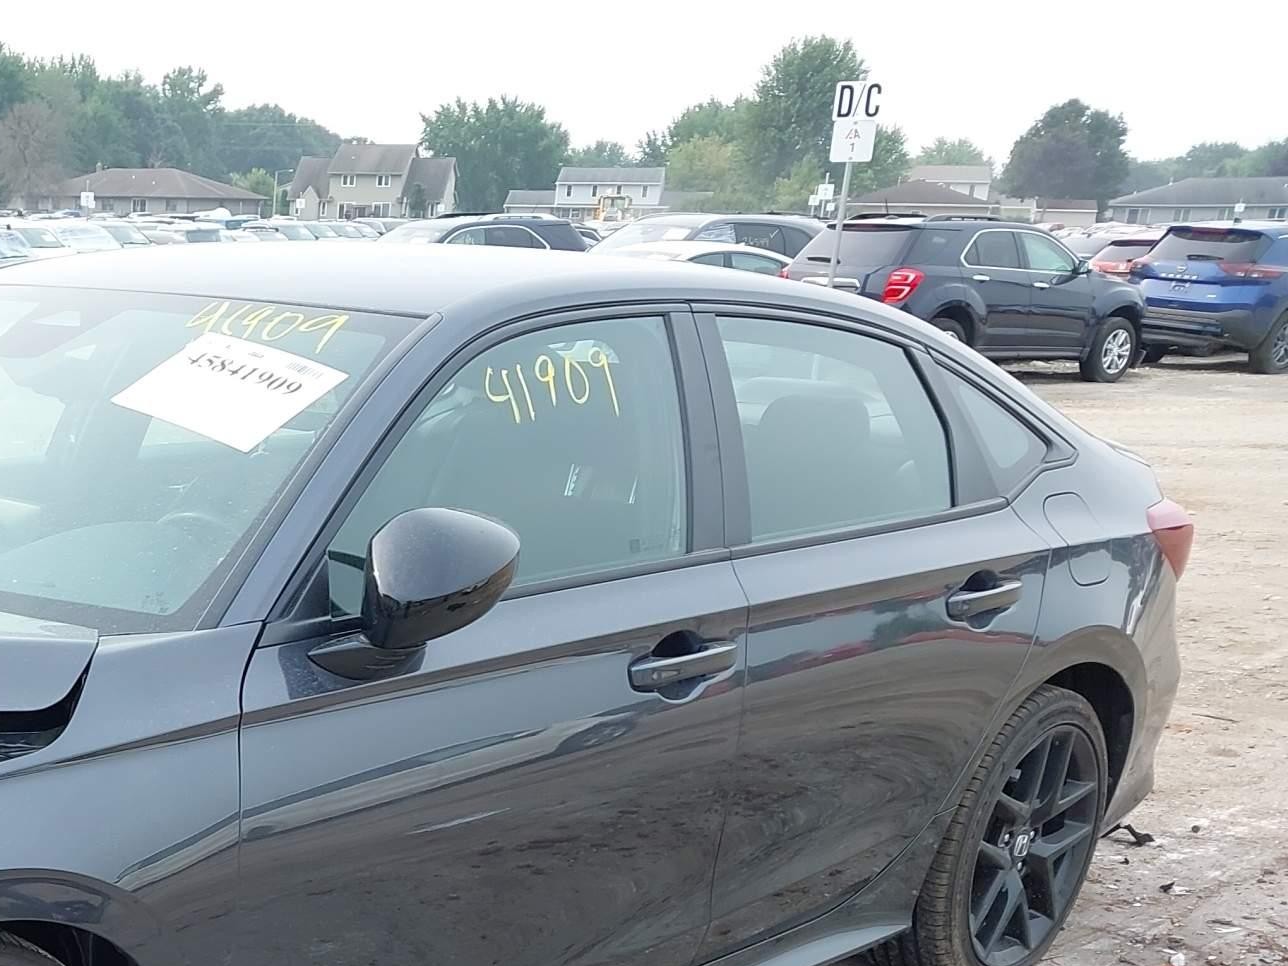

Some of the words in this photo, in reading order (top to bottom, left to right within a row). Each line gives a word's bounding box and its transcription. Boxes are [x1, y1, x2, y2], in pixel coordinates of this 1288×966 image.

[837, 83, 882, 118] D/C
[185, 301, 350, 353] 41909
[188, 352, 304, 395] 45841909
[485, 347, 619, 424] 41909
